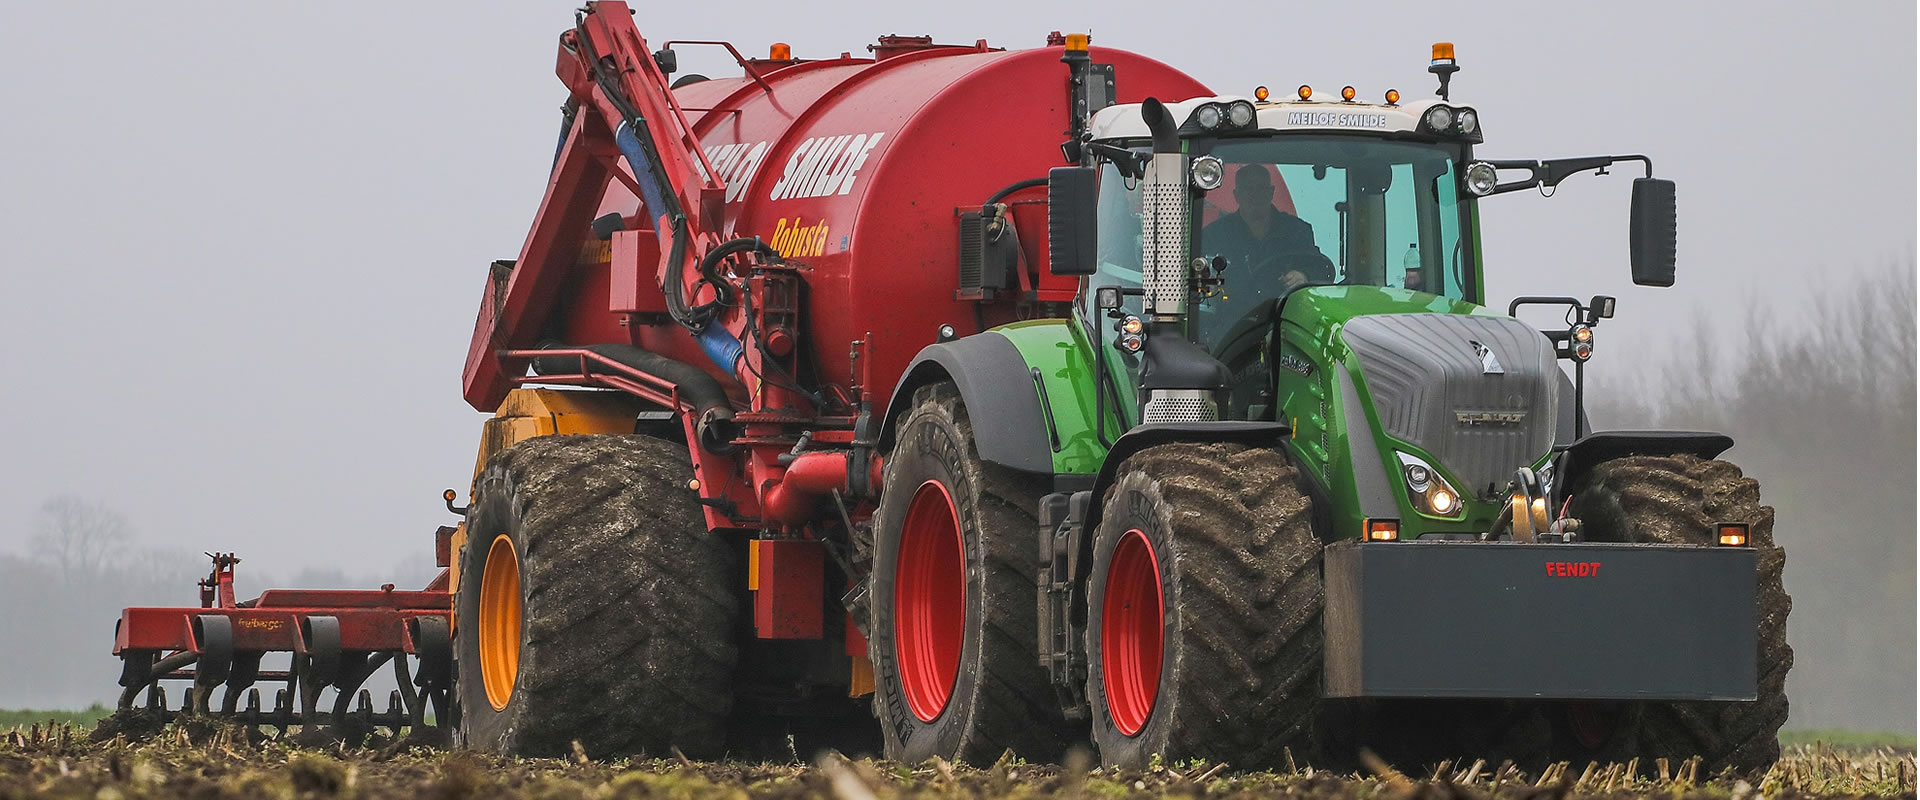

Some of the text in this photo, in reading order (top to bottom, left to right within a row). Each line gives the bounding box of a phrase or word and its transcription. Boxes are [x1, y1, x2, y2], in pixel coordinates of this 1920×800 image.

[1287, 111, 1386, 128] MEILOF SMILDE
[769, 132, 885, 201] SMILDE
[769, 217, 829, 259] Robusta
[1545, 562, 1601, 577] FENDT
